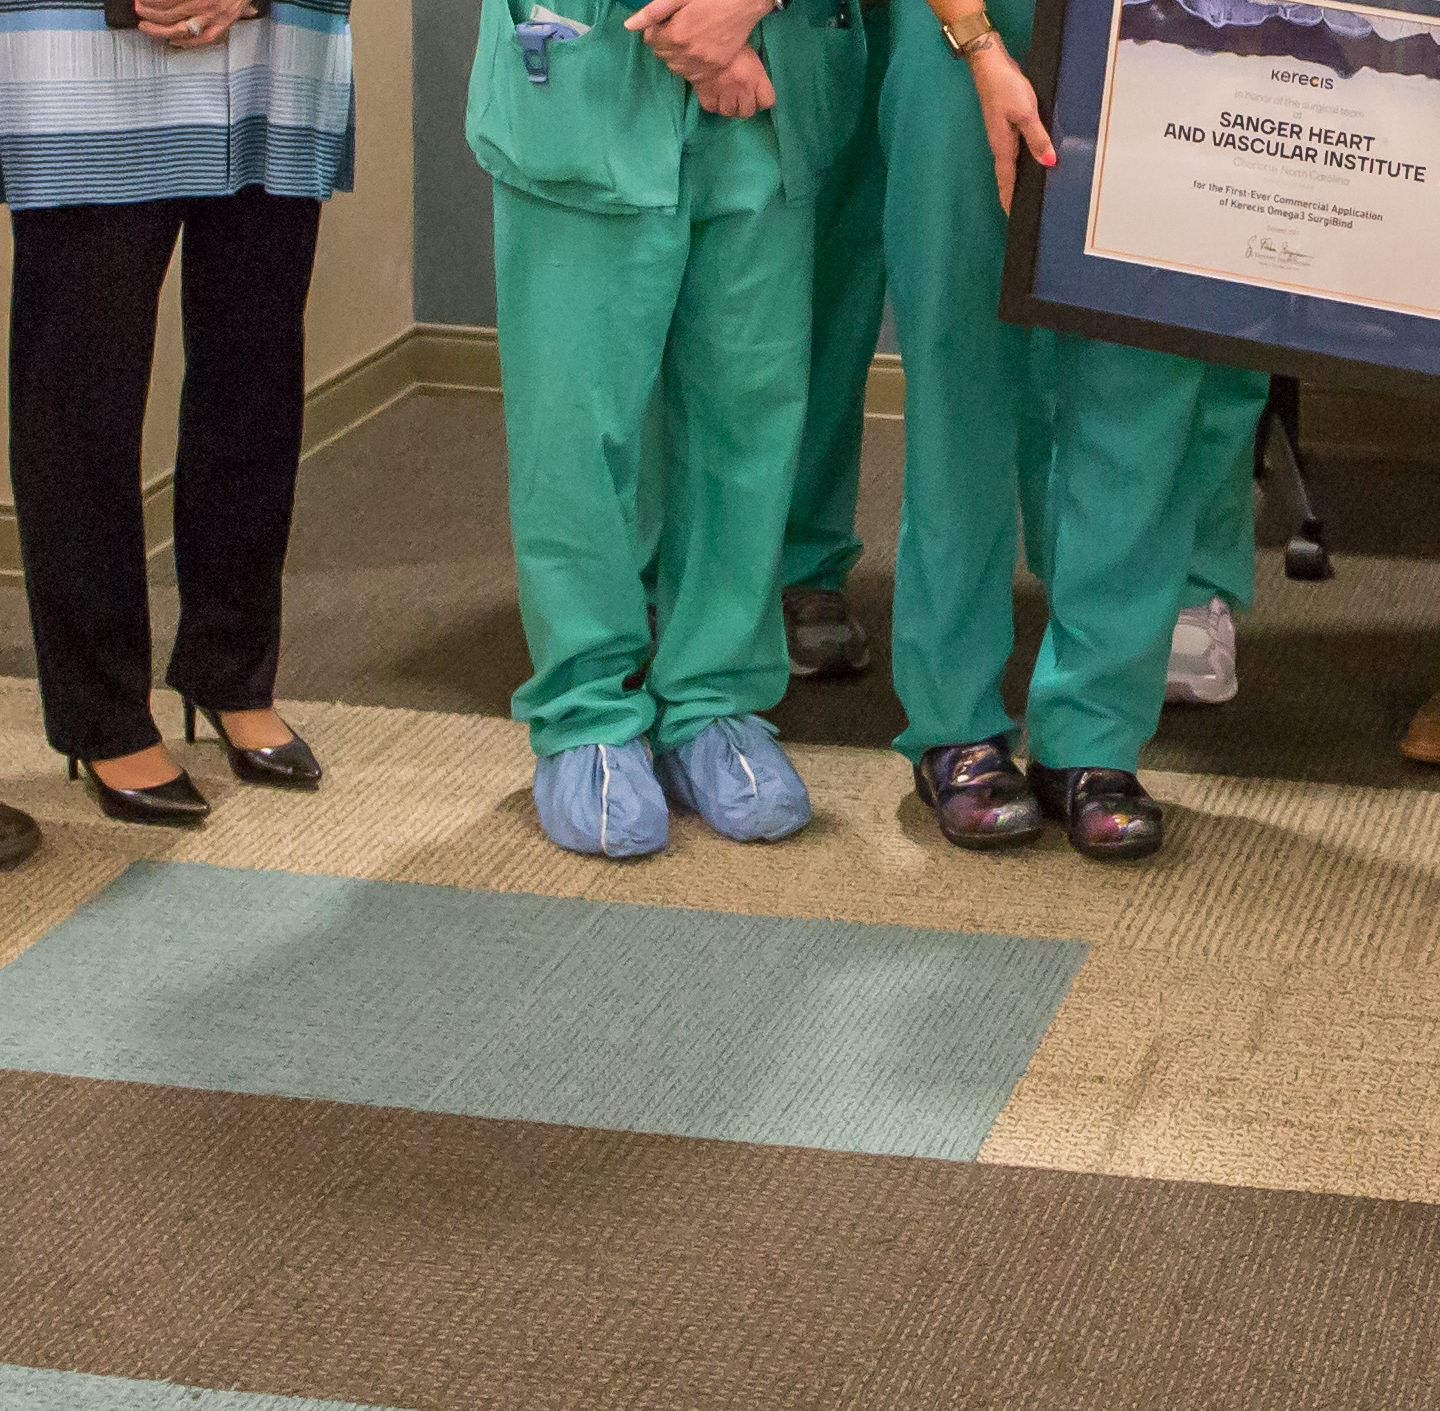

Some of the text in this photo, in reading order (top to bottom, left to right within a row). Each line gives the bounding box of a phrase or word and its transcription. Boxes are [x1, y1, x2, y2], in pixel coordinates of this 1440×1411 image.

[1220, 111, 1375, 152] SANGER HEART
[1164, 123, 1427, 182] AND VASCULAR INSTITUTE
[1193, 180, 1383, 222] for the First-Ever Commercial Application
[1219, 197, 1353, 229] of Kerecis Omega3 SurgiBind
